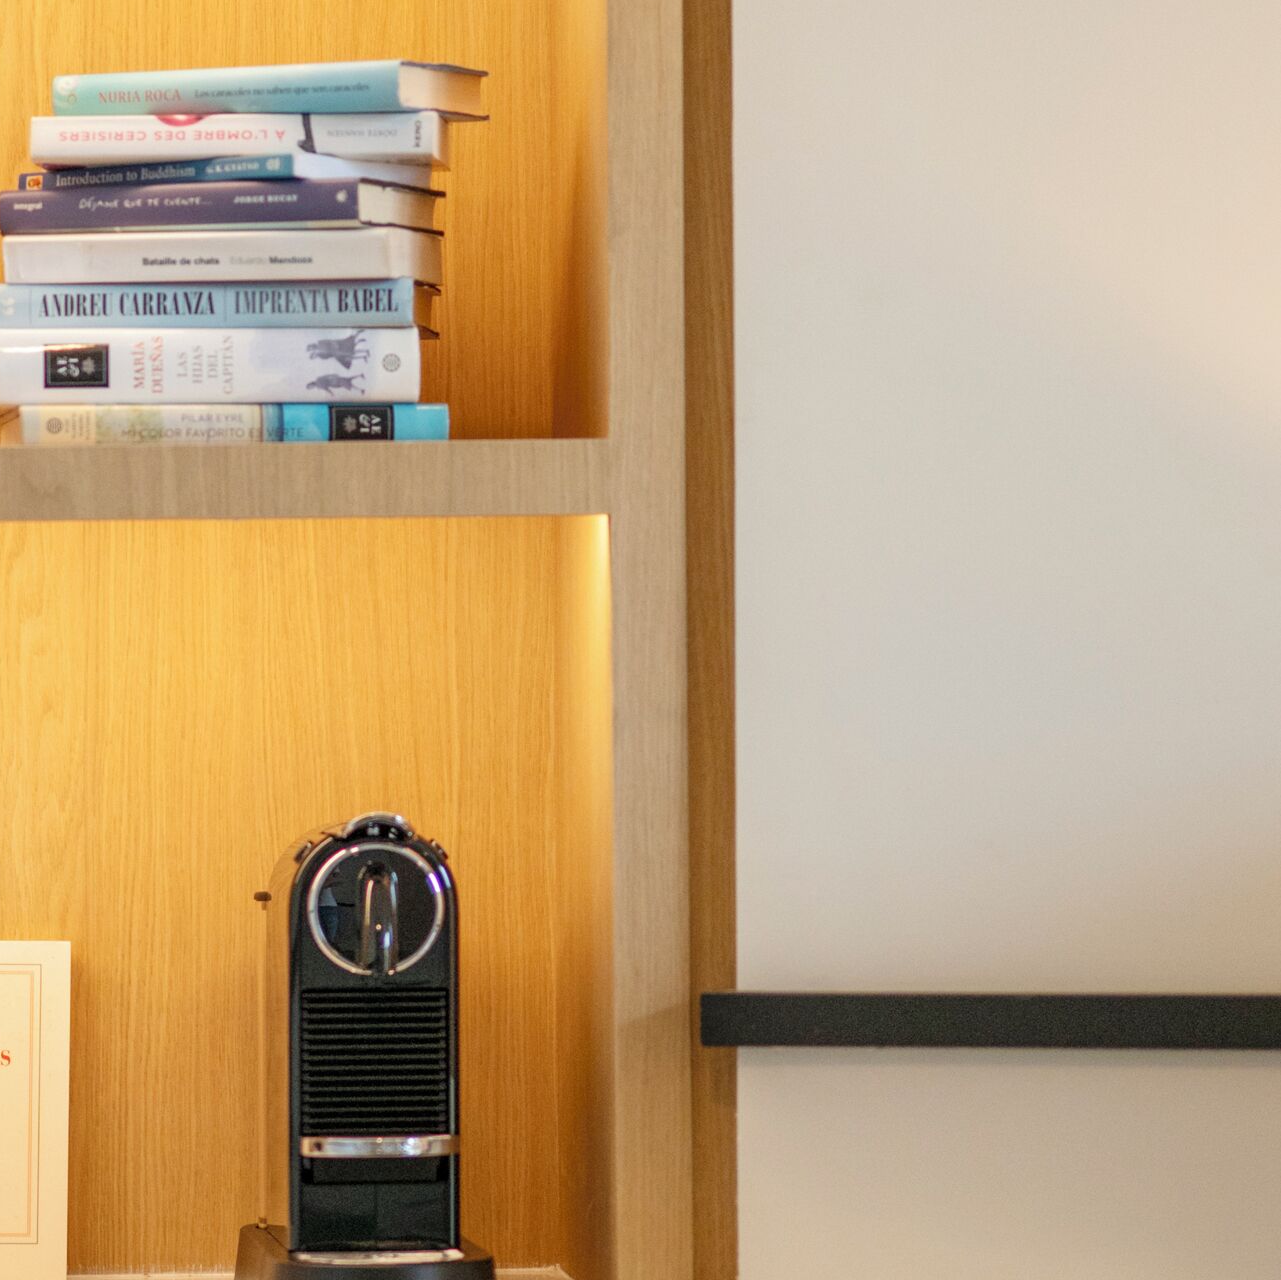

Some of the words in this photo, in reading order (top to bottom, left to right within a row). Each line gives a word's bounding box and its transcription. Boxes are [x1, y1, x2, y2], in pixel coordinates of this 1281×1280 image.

[98, 91, 141, 104] NURIA
[144, 88, 182, 102] ROCA
[59, 130, 147, 142] CERISIERS
[153, 130, 186, 142] DES
[193, 129, 270, 141] L'OMBRE
[55, 172, 123, 187] Introduction
[126, 171, 138, 183] to
[140, 166, 196, 180] Buddhism
[79, 197, 119, 211] DÉJAME
[123, 198, 142, 208] QUE
[147, 198, 160, 206] TE
[142, 257, 176, 266] Bataille
[179, 257, 191, 266] de
[193, 256, 220, 266] chats
[269, 255, 313, 265] Mendoza
[38, 292, 113, 317] ANDREU
[119, 290, 215, 317] CARRANZA
[234, 289, 330, 316] IMPRENTA
[337, 287, 400, 314] BABEL
[131, 341, 145, 389] MARÍA
[150, 336, 163, 393] DUEÑAS
[177, 352, 188, 378] LAS
[192, 345, 203, 384] HIJAS
[207, 351, 218, 379] DEL
[221, 336, 233, 394] CAPITÁN
[181, 414, 213, 424] PILAR
[216, 413, 244, 423] EYRE
[139, 428, 182, 439] COLOR
[185, 427, 246, 439] FAVORITO
[266, 427, 304, 438] VERTE
